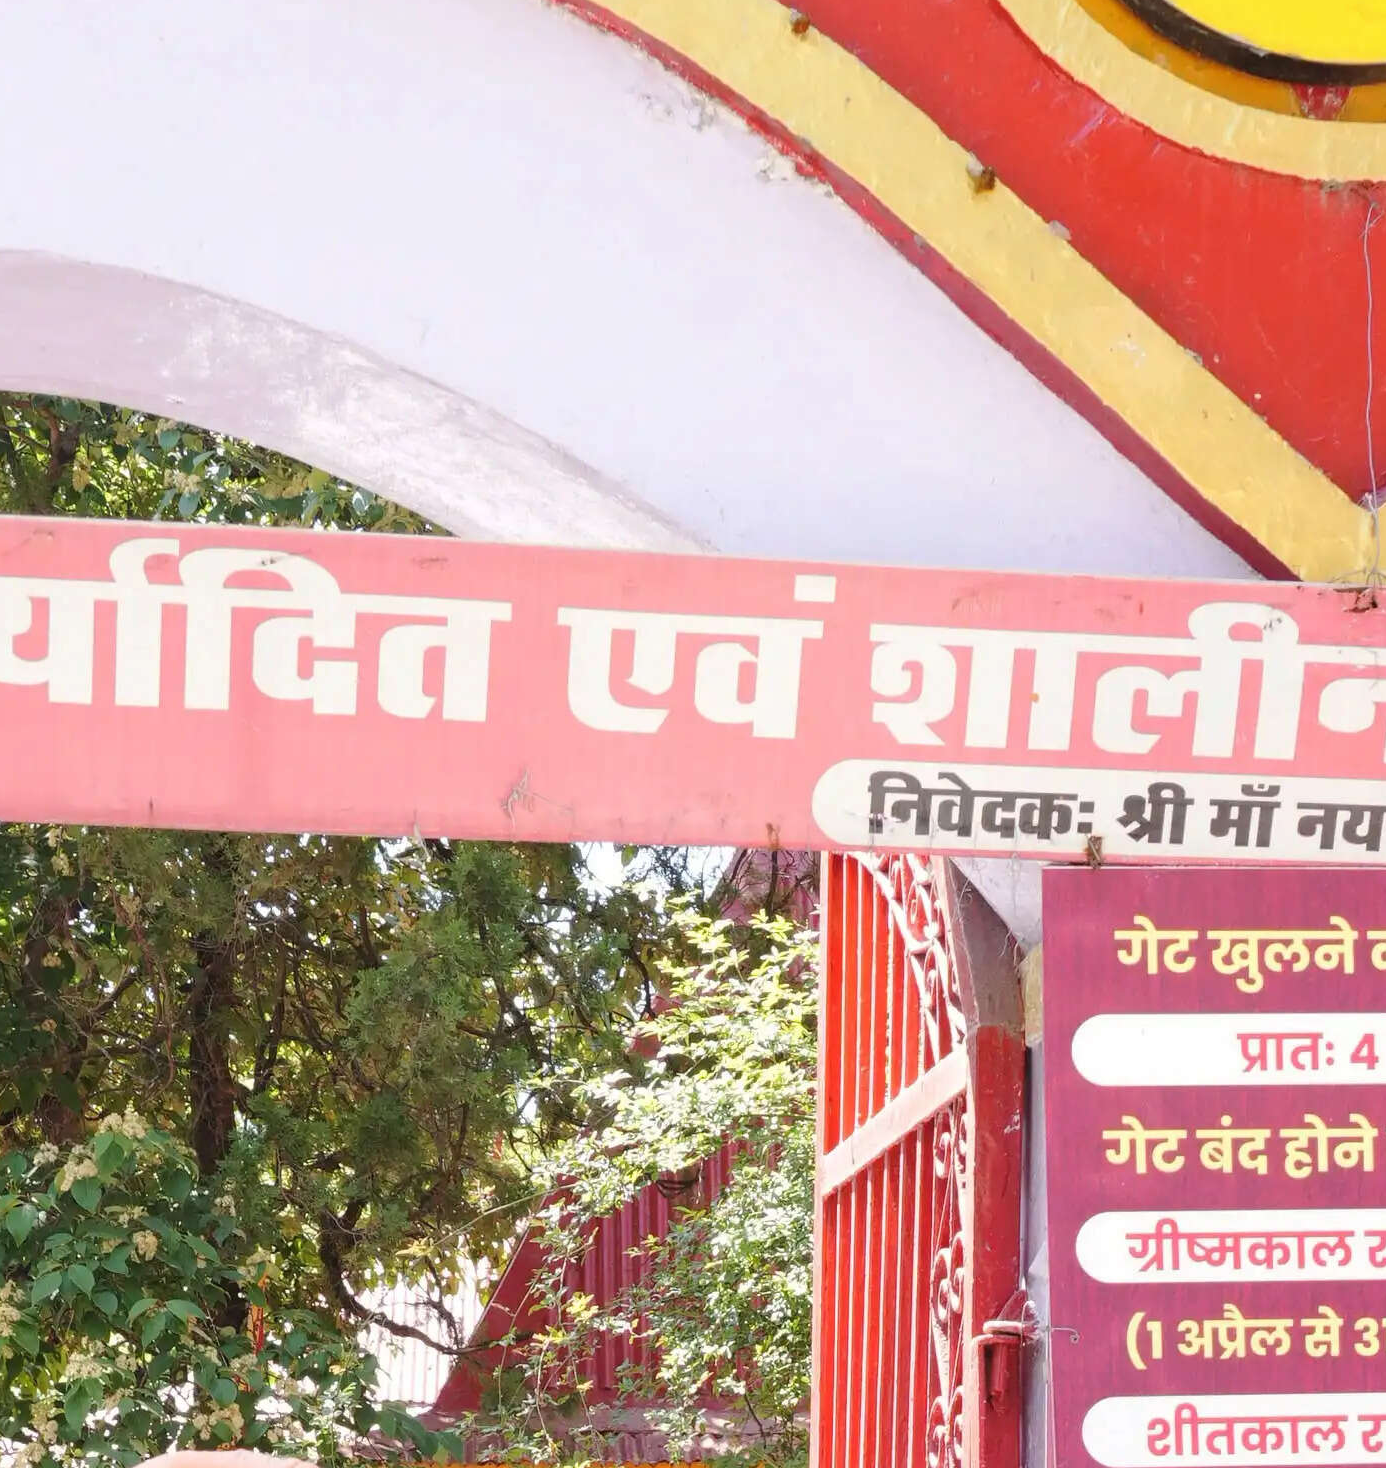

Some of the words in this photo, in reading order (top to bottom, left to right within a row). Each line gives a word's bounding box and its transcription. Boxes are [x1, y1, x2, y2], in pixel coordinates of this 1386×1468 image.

[558, 575, 836, 740] एवं
[1116, 781, 1194, 845] श्री
[1209, 784, 1281, 848] माँ
[1114, 916, 1198, 974] गेट
[1208, 917, 1358, 993] खुलने
[1237, 1032, 1335, 1072] प्रातः
[1350, 1034, 1379, 1070] 4
[1103, 1115, 1187, 1174] गेट
[1196, 1115, 1271, 1175] बंद
[1280, 1113, 1377, 1179] होने
[1126, 1217, 1354, 1273] ग्रीष्मकाल
[1126, 1310, 1162, 1370] (1
[1178, 1303, 1294, 1358] अप्रैल
[1300, 1305, 1344, 1357] से
[1146, 1402, 1348, 1458] शीतकाल
